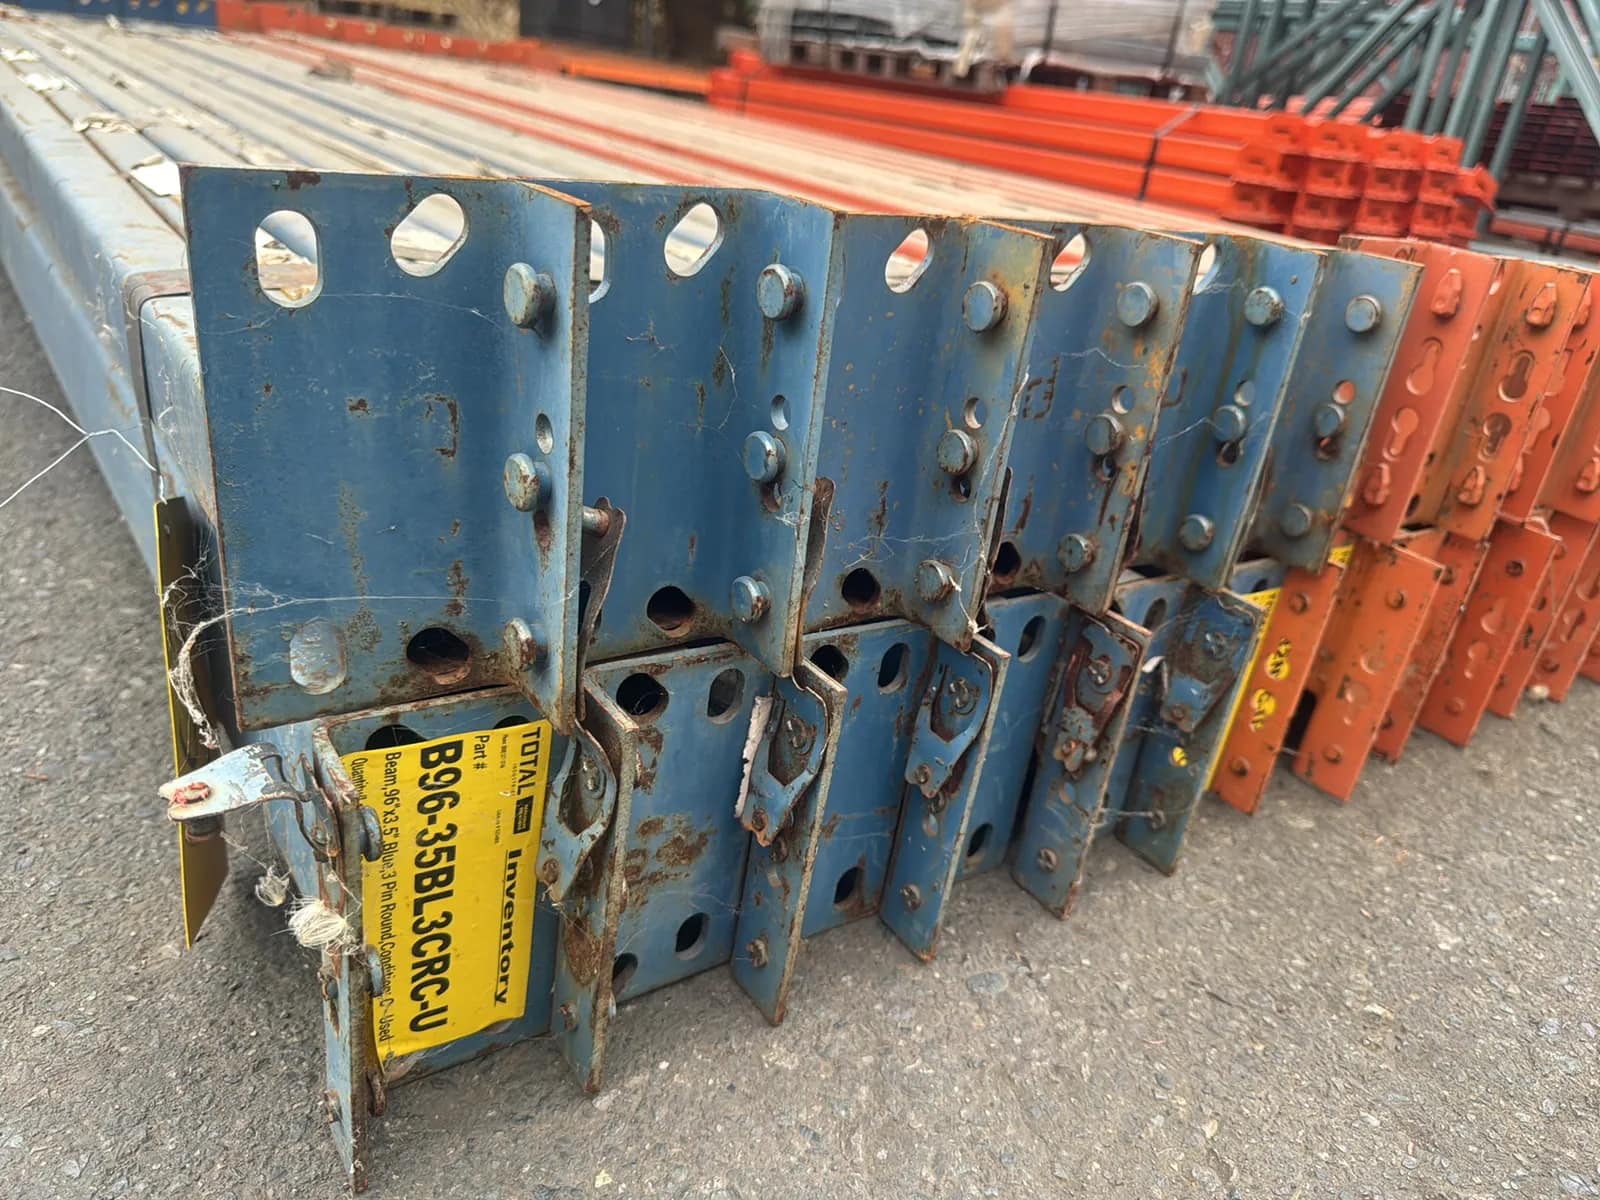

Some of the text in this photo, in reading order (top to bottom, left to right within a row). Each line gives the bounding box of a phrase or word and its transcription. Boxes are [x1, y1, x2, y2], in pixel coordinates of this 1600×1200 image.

[474, 734, 490, 770] Part #
[516, 727, 541, 796] TOTAL
[380, 881, 398, 901] Pin
[409, 739, 464, 1033] B96-35BL3CRC-U
[494, 849, 522, 1005] Inventory
[379, 1015, 394, 1042] Used
